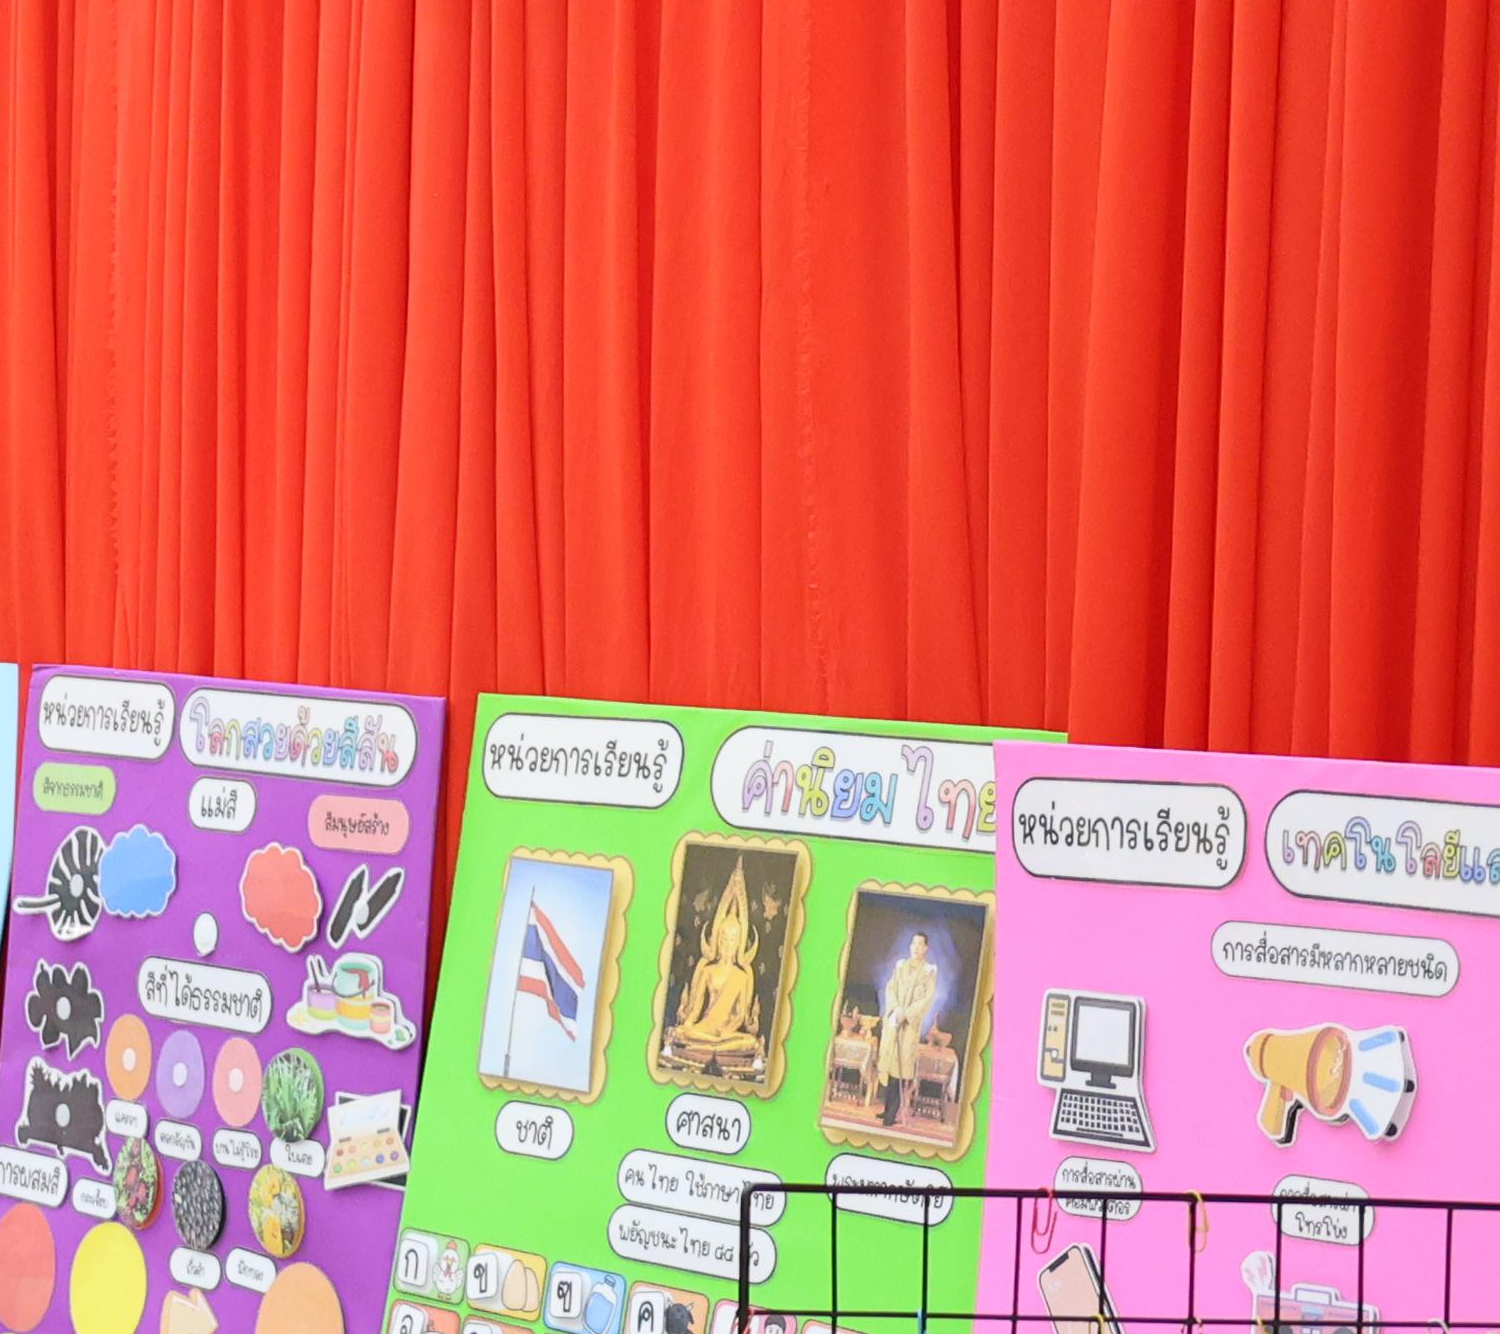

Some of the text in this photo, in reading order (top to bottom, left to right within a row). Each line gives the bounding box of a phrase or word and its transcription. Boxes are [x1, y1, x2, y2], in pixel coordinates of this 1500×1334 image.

[42, 697, 166, 747] หน่วยการเรียนรู้
[188, 695, 400, 774] โลกสวยด้วยสีสัน
[489, 735, 669, 795] หน่วยการเรียนรู้
[200, 789, 238, 820] แม่สี
[1017, 799, 1231, 872] หน่วยการเรียนรู้
[1221, 930, 1449, 983] การสื่อสารมีหลากหลายชนิด
[516, 1114, 553, 1150] ชาติ
[675, 1110, 742, 1143] ศาสนา
[404, 1249, 420, 1276] ก
[472, 1261, 489, 1295] ข
